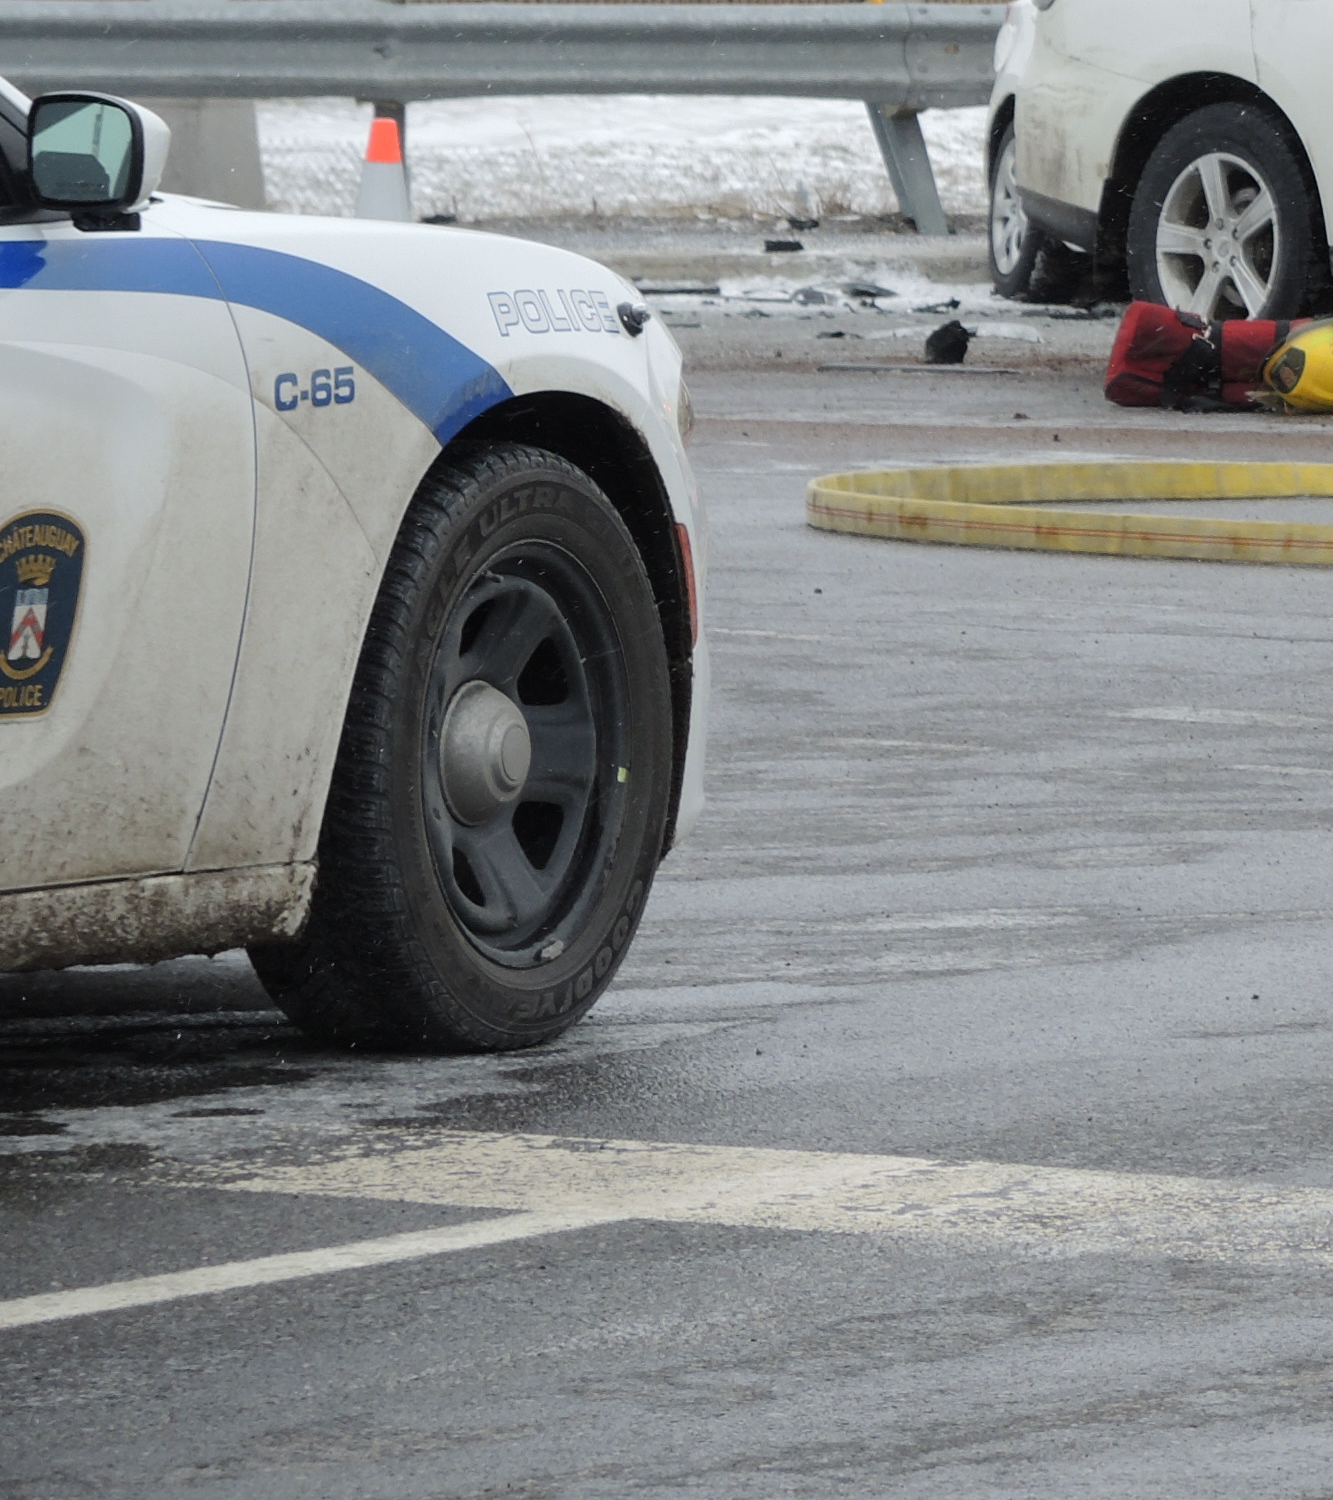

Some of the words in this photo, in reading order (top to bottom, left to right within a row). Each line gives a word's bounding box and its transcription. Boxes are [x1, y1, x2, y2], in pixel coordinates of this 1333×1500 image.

[487, 289, 621, 336] POLICE
[274, 366, 355, 411] C-65
[478, 485, 575, 535] ULTRA
